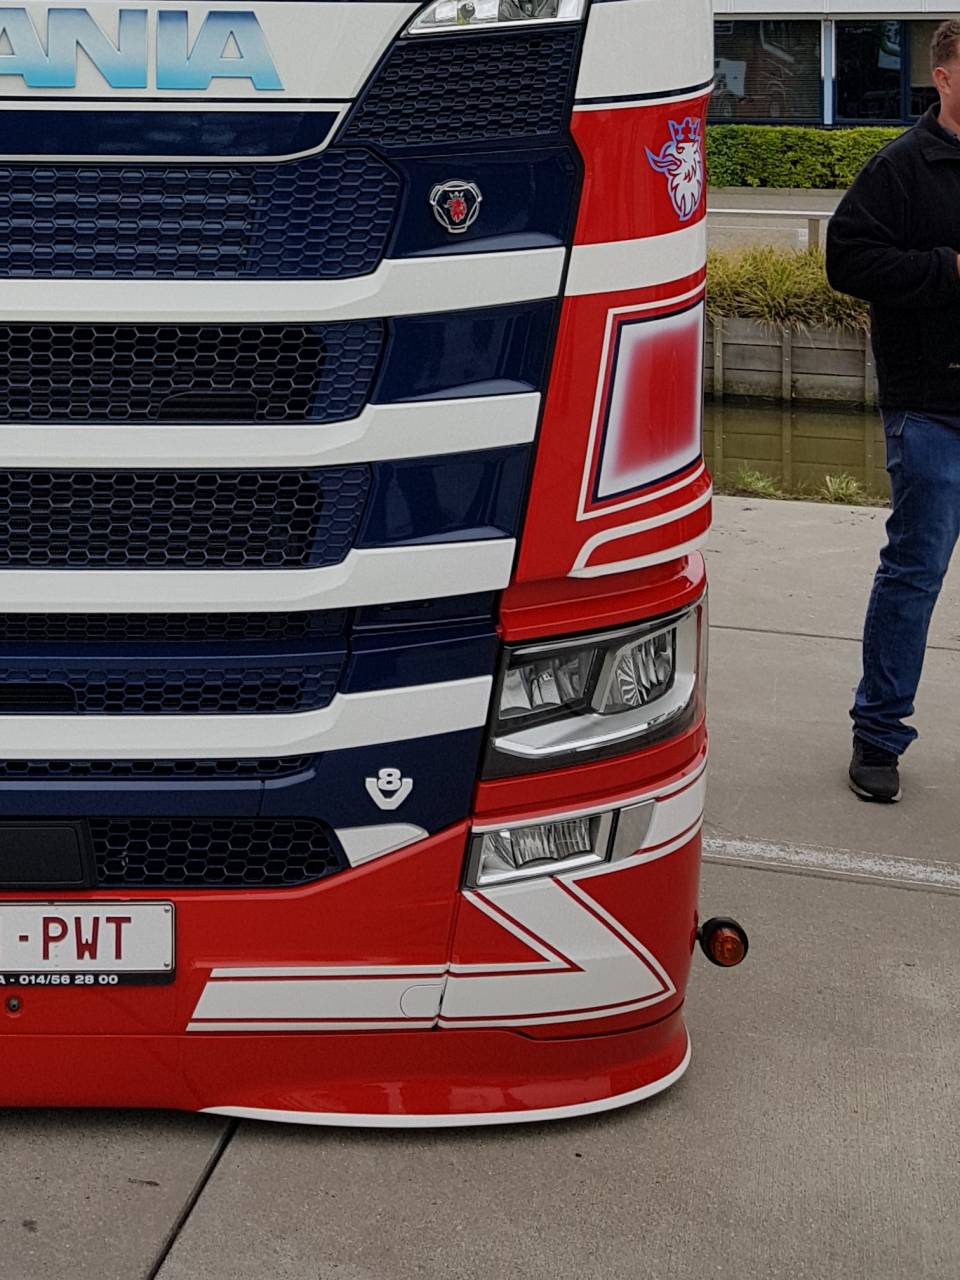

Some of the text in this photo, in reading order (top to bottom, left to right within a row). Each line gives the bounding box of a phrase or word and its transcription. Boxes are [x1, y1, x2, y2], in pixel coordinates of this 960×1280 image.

[19, 975, 71, 986] 014/56
[74, 975, 95, 985] 28
[98, 975, 119, 986] 00
